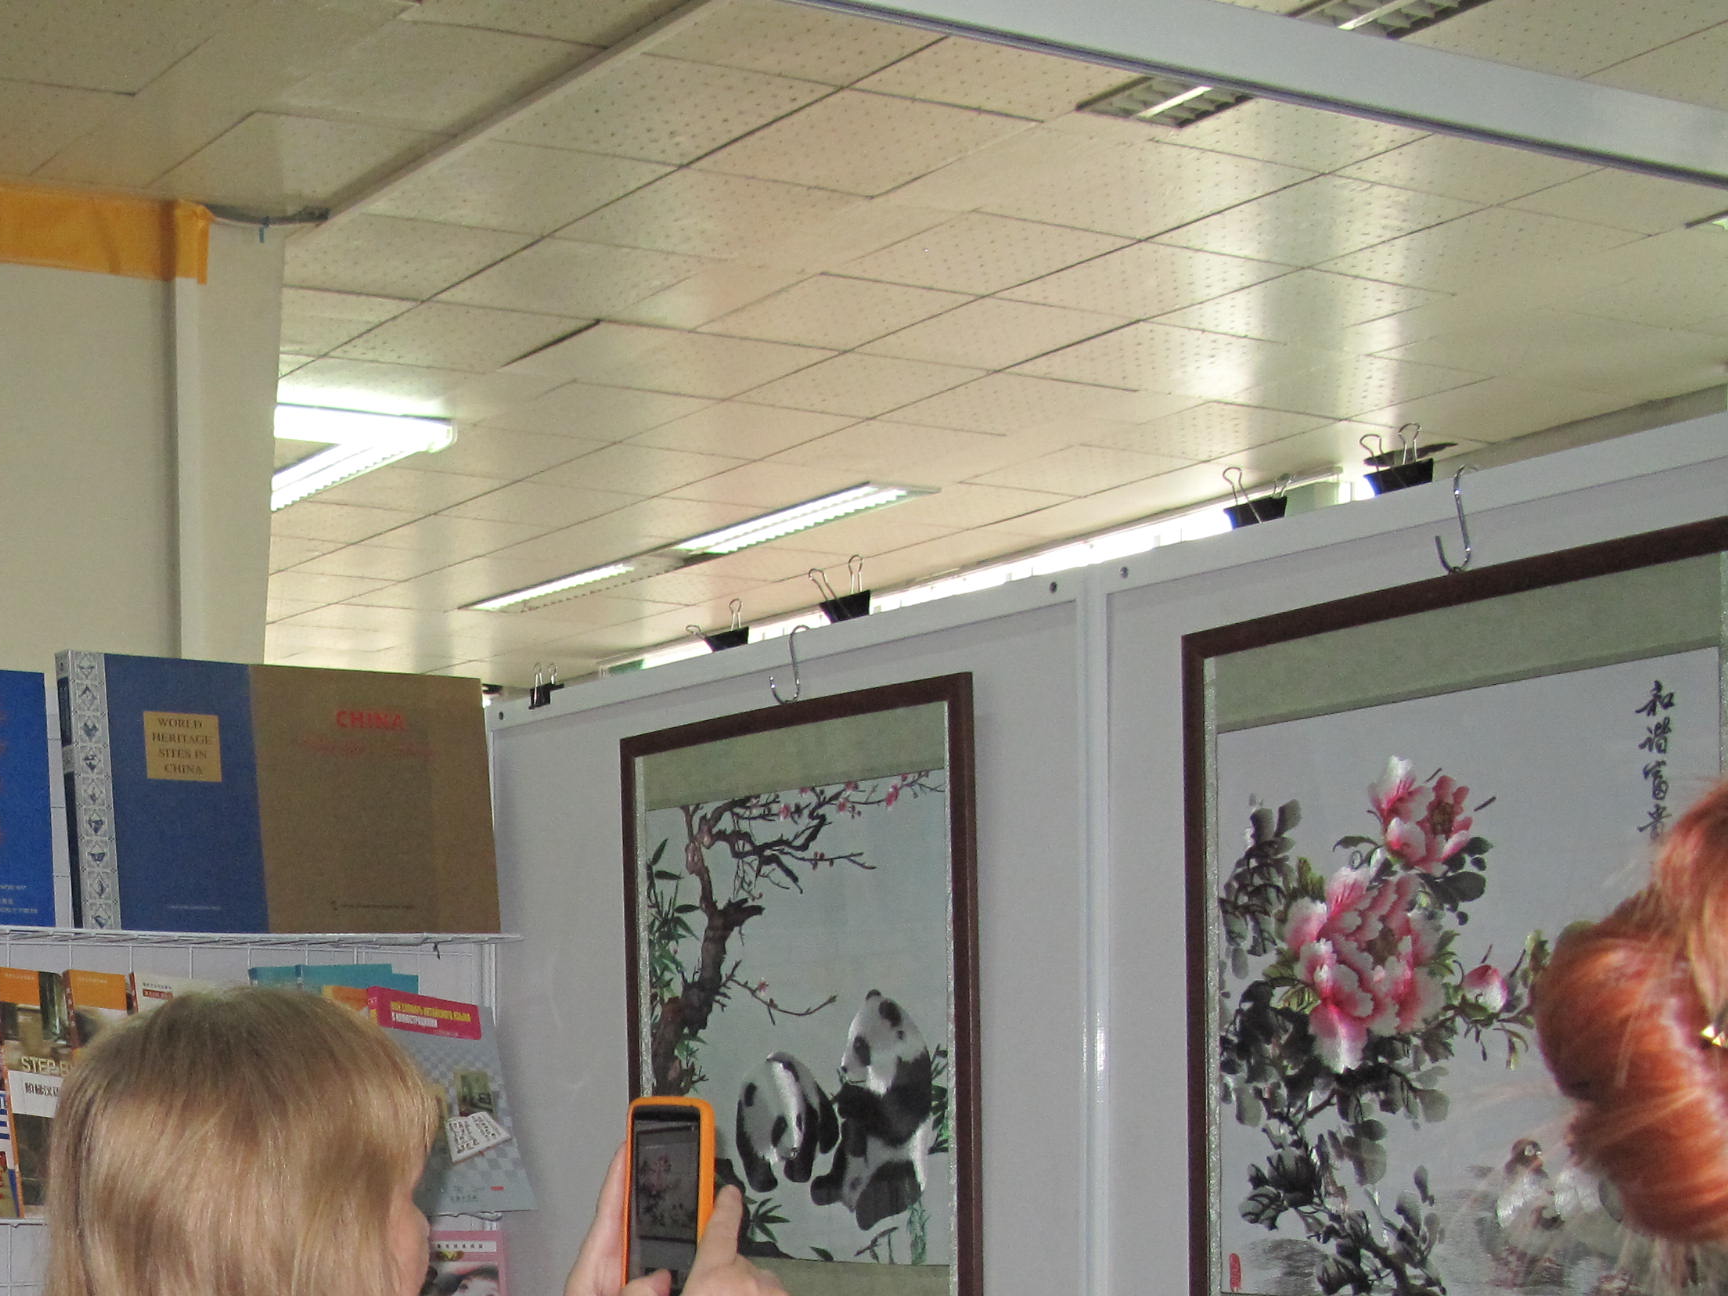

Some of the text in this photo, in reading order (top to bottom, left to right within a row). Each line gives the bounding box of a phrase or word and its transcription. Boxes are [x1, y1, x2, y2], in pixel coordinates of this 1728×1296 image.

[157, 717, 203, 729] WORLD
[336, 710, 407, 731] CHINA
[152, 732, 210, 746] HERITAGE
[158, 748, 207, 760] SITES IN
[164, 763, 203, 776] CHINA
